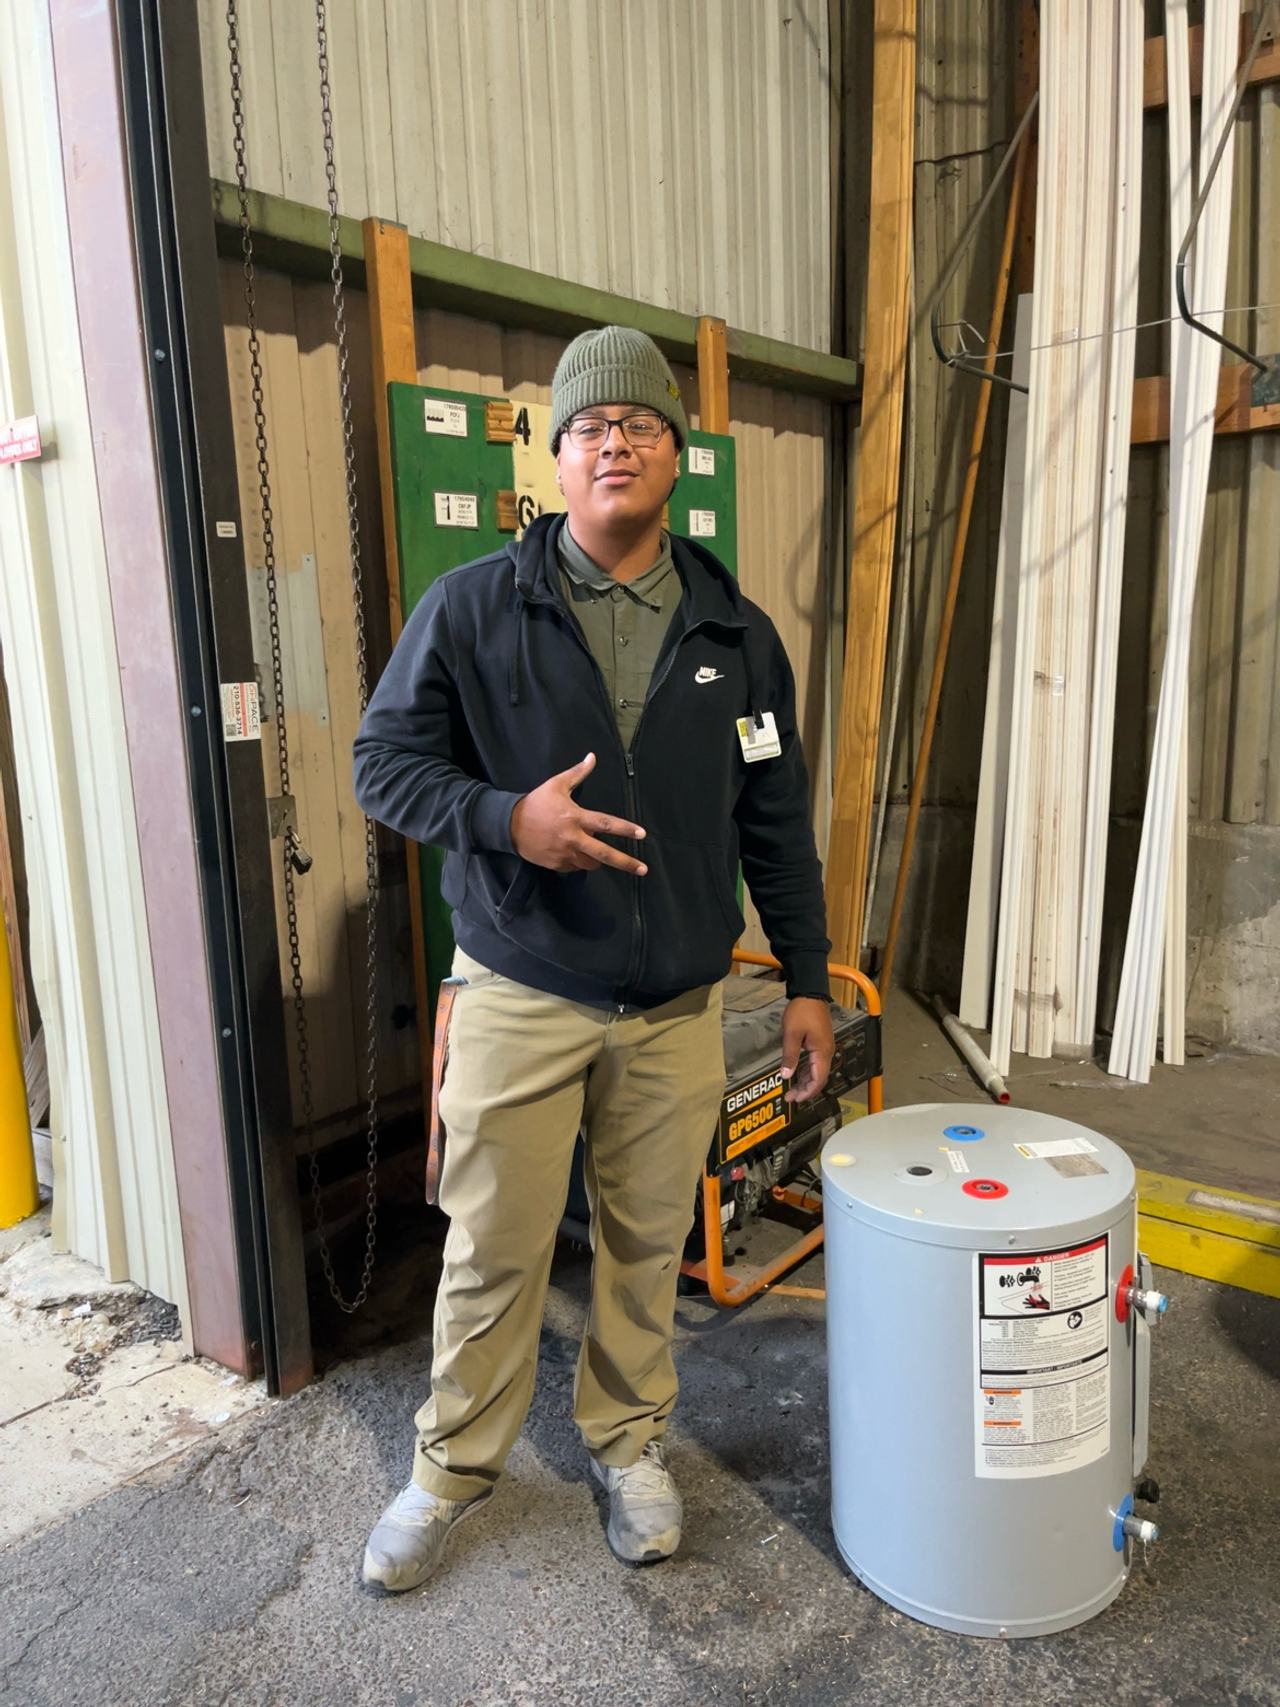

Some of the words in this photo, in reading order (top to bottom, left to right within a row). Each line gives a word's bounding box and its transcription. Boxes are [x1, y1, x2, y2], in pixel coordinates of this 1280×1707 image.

[514, 407, 531, 446] 4
[699, 666, 717, 677] NIKE
[727, 1073, 783, 1112] GENERAC
[729, 1103, 774, 1140] GP6500
